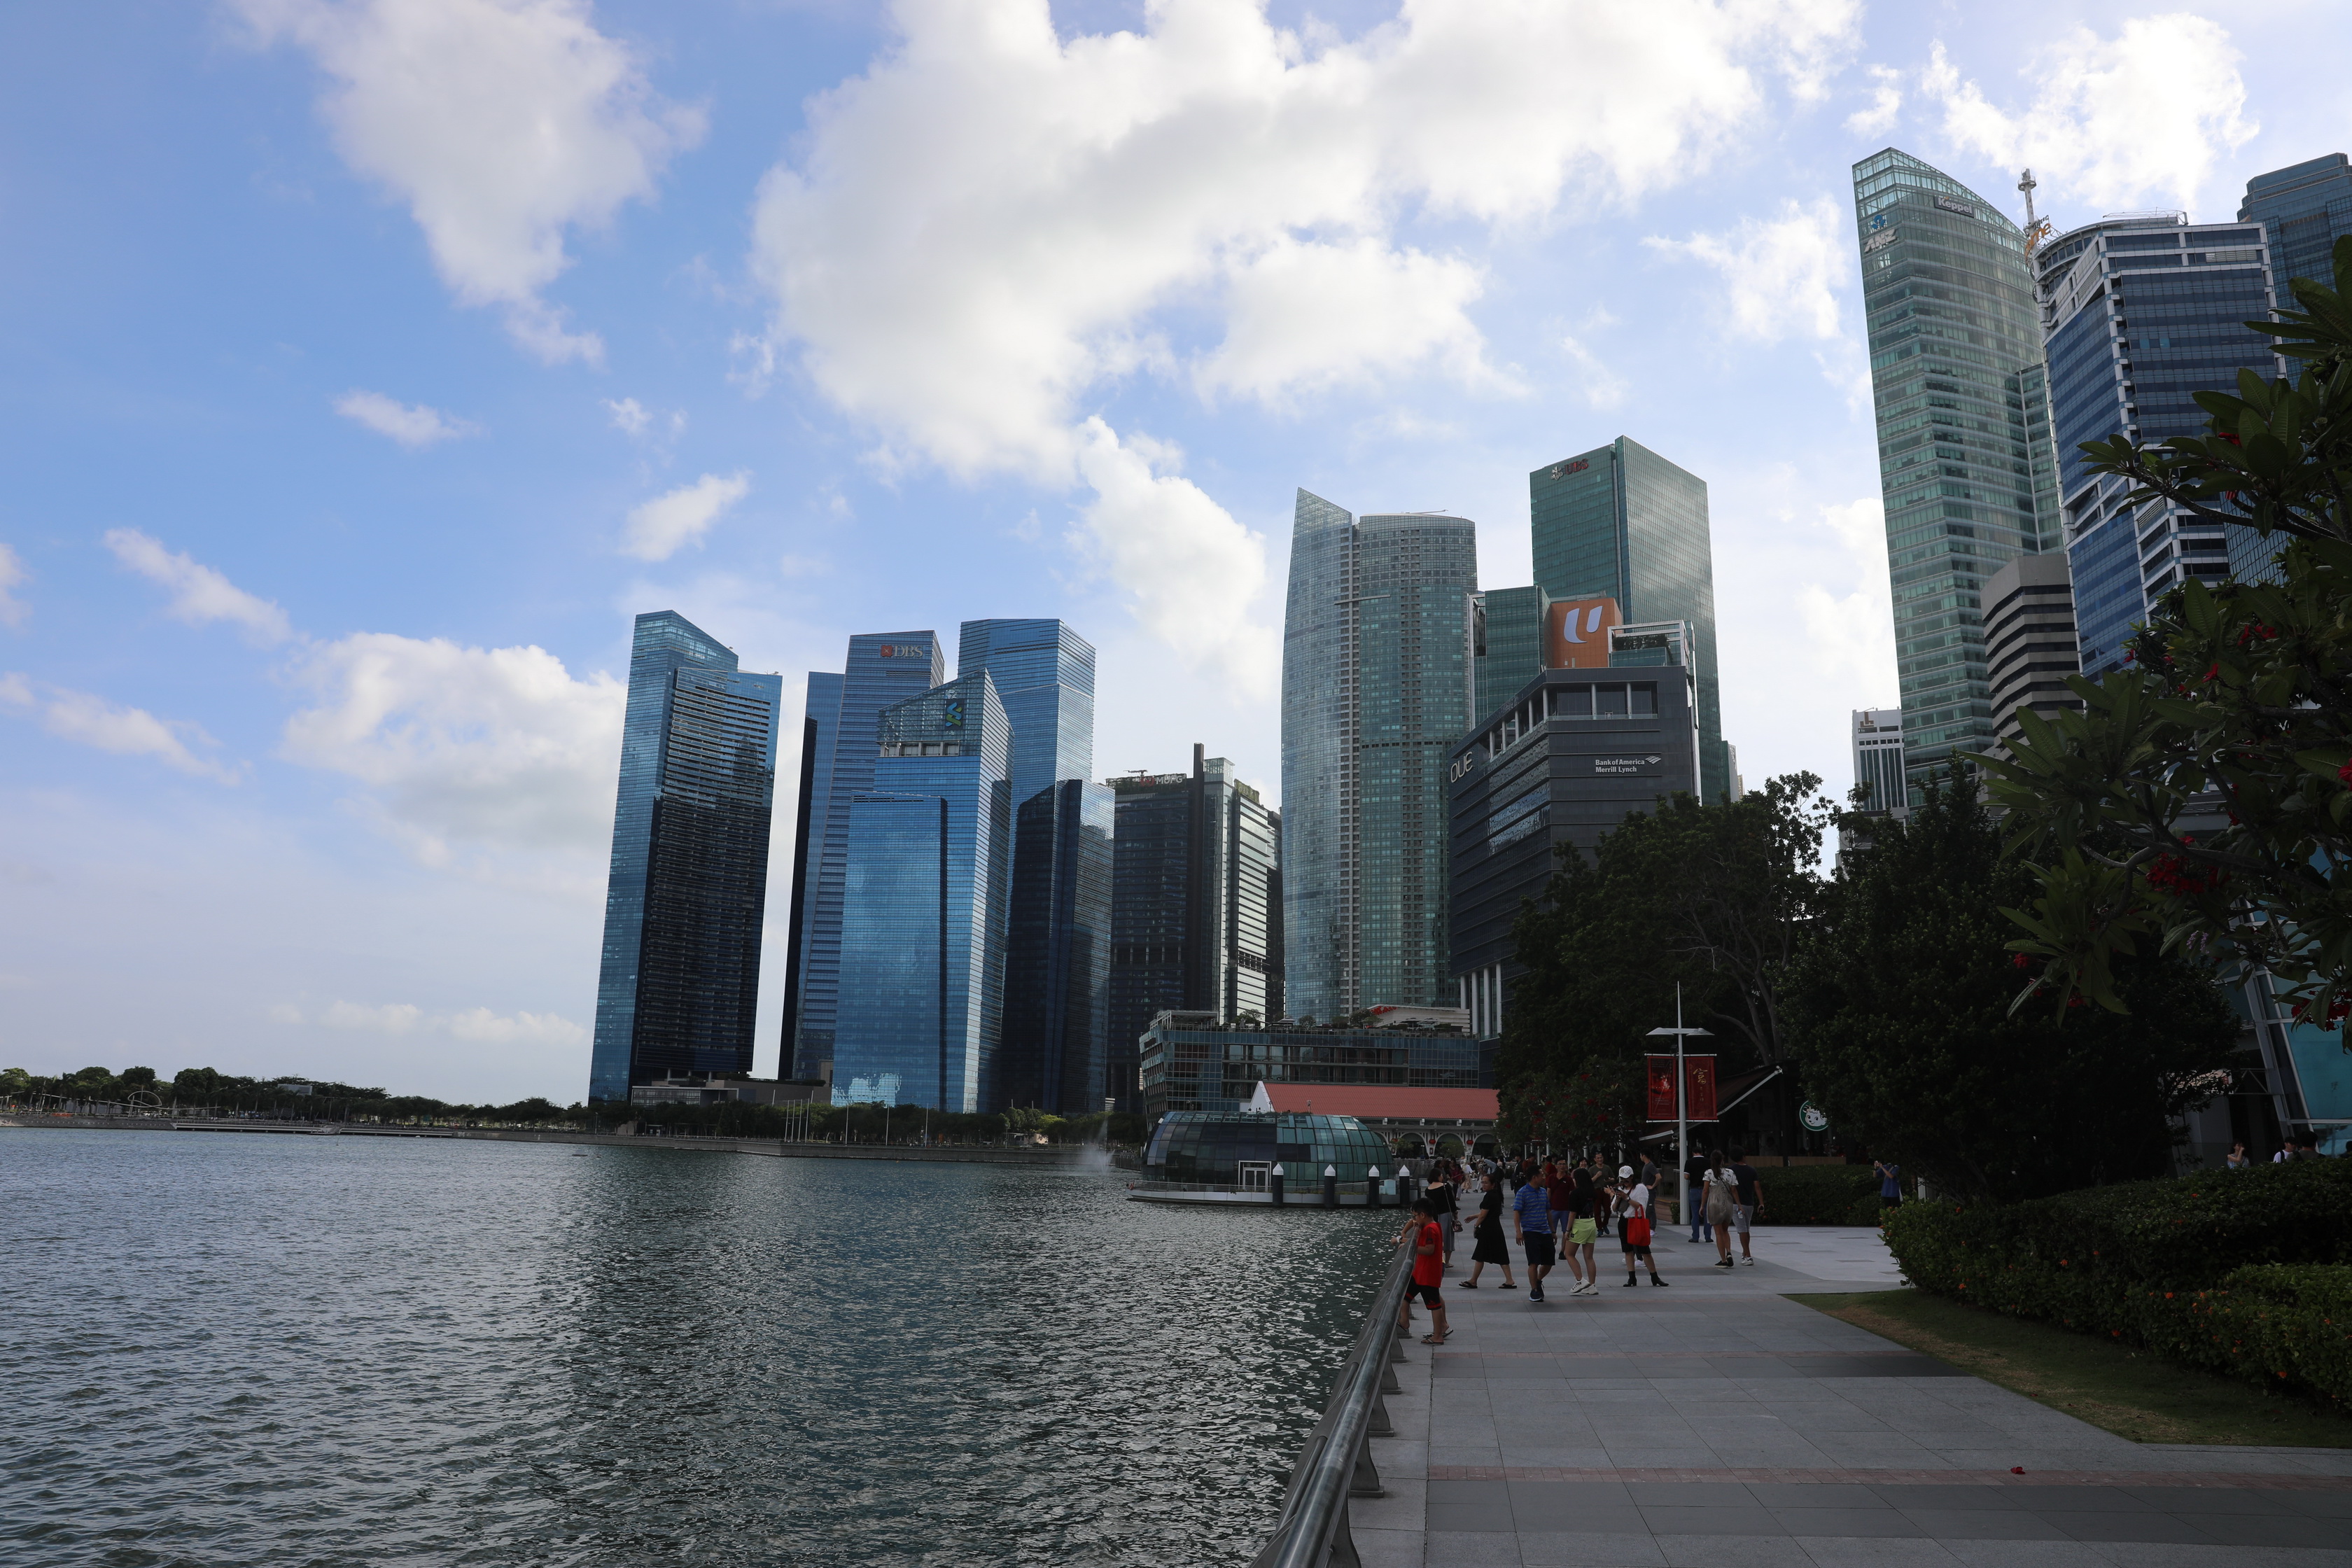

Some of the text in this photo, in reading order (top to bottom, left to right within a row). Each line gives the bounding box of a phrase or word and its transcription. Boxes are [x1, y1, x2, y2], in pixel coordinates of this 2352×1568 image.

[1938, 197, 1973, 214] Keppel
[1864, 229, 1897, 253] ANZ
[1564, 458, 1589, 475] UBS
[895, 645, 923, 658] DBS
[1450, 751, 1473, 783] OUE
[1156, 775, 1183, 785] MUFG
